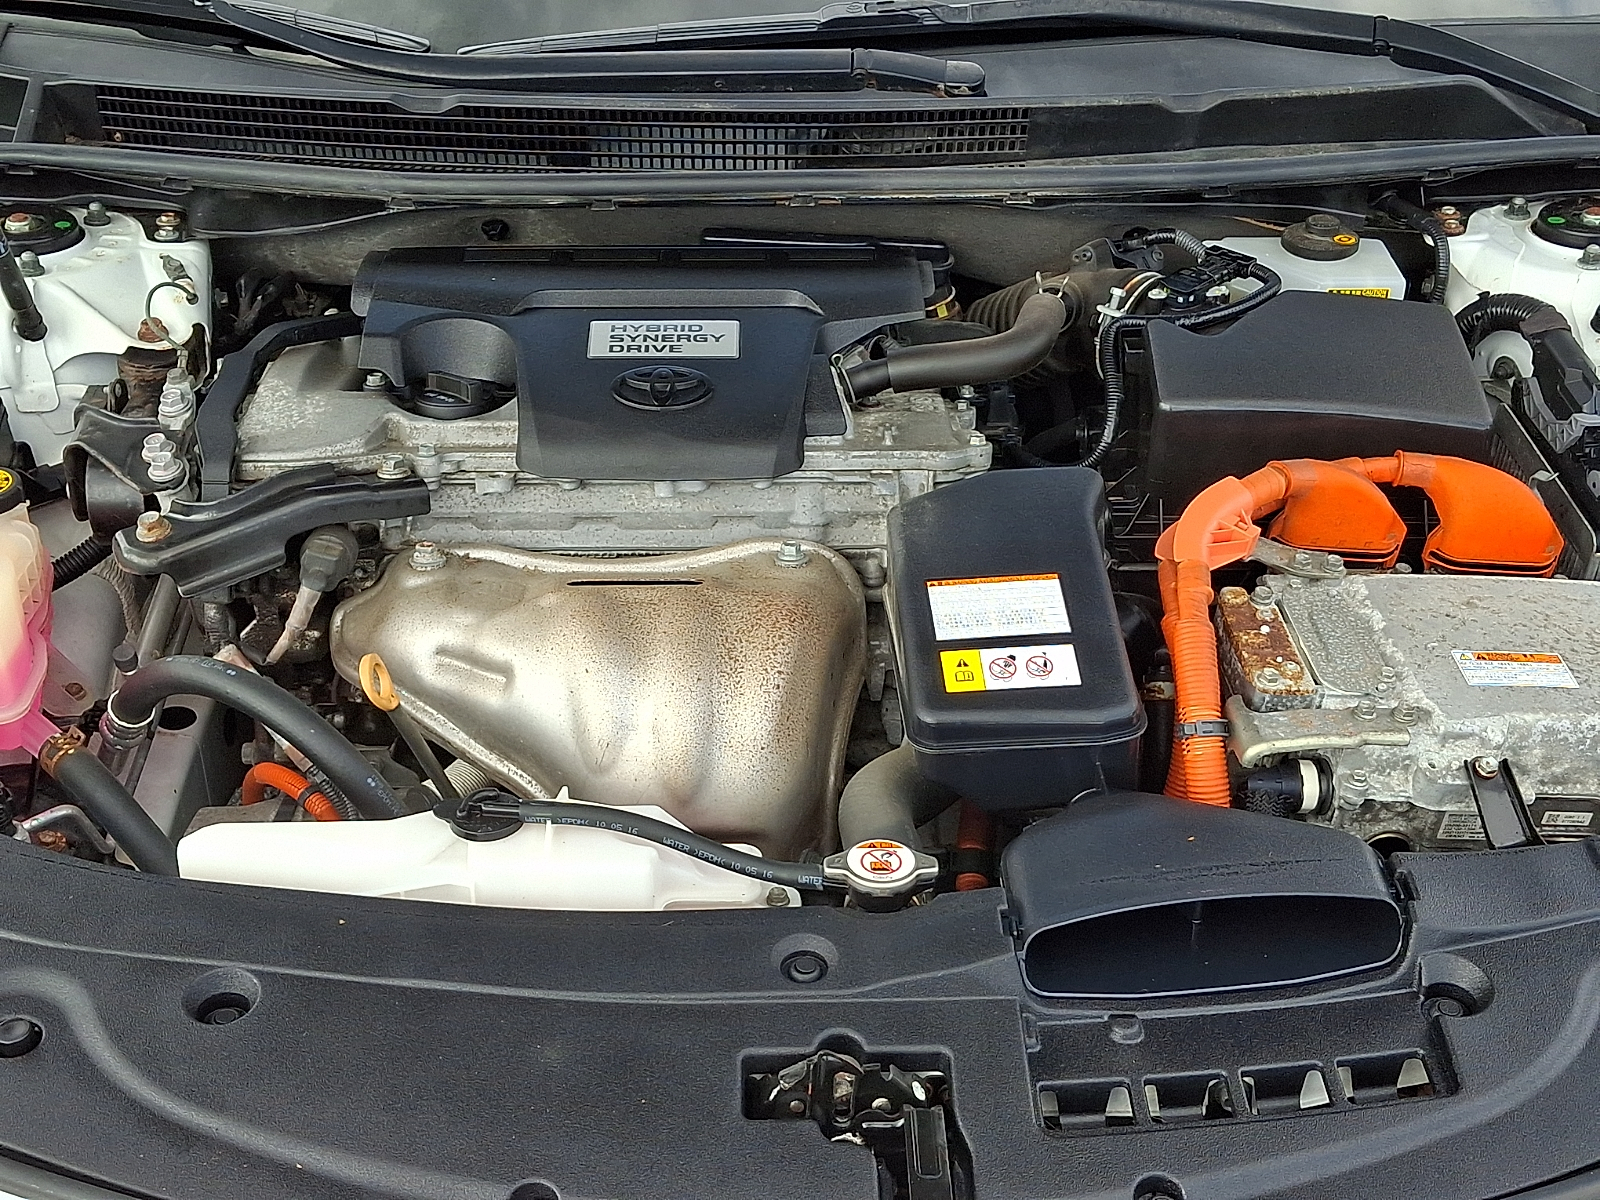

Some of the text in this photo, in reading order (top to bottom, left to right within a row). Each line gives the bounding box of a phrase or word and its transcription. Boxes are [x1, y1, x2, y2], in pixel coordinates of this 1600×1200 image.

[610, 324, 704, 333] HYBRID
[609, 334, 726, 343] SYNERGY
[608, 344, 684, 353] DRIVE
[595, 820, 607, 828] 10
[627, 826, 639, 835] 16
[662, 837, 691, 851] WATER
[729, 860, 741, 871] 10
[745, 866, 758, 876] 05
[761, 869, 774, 879] 16
